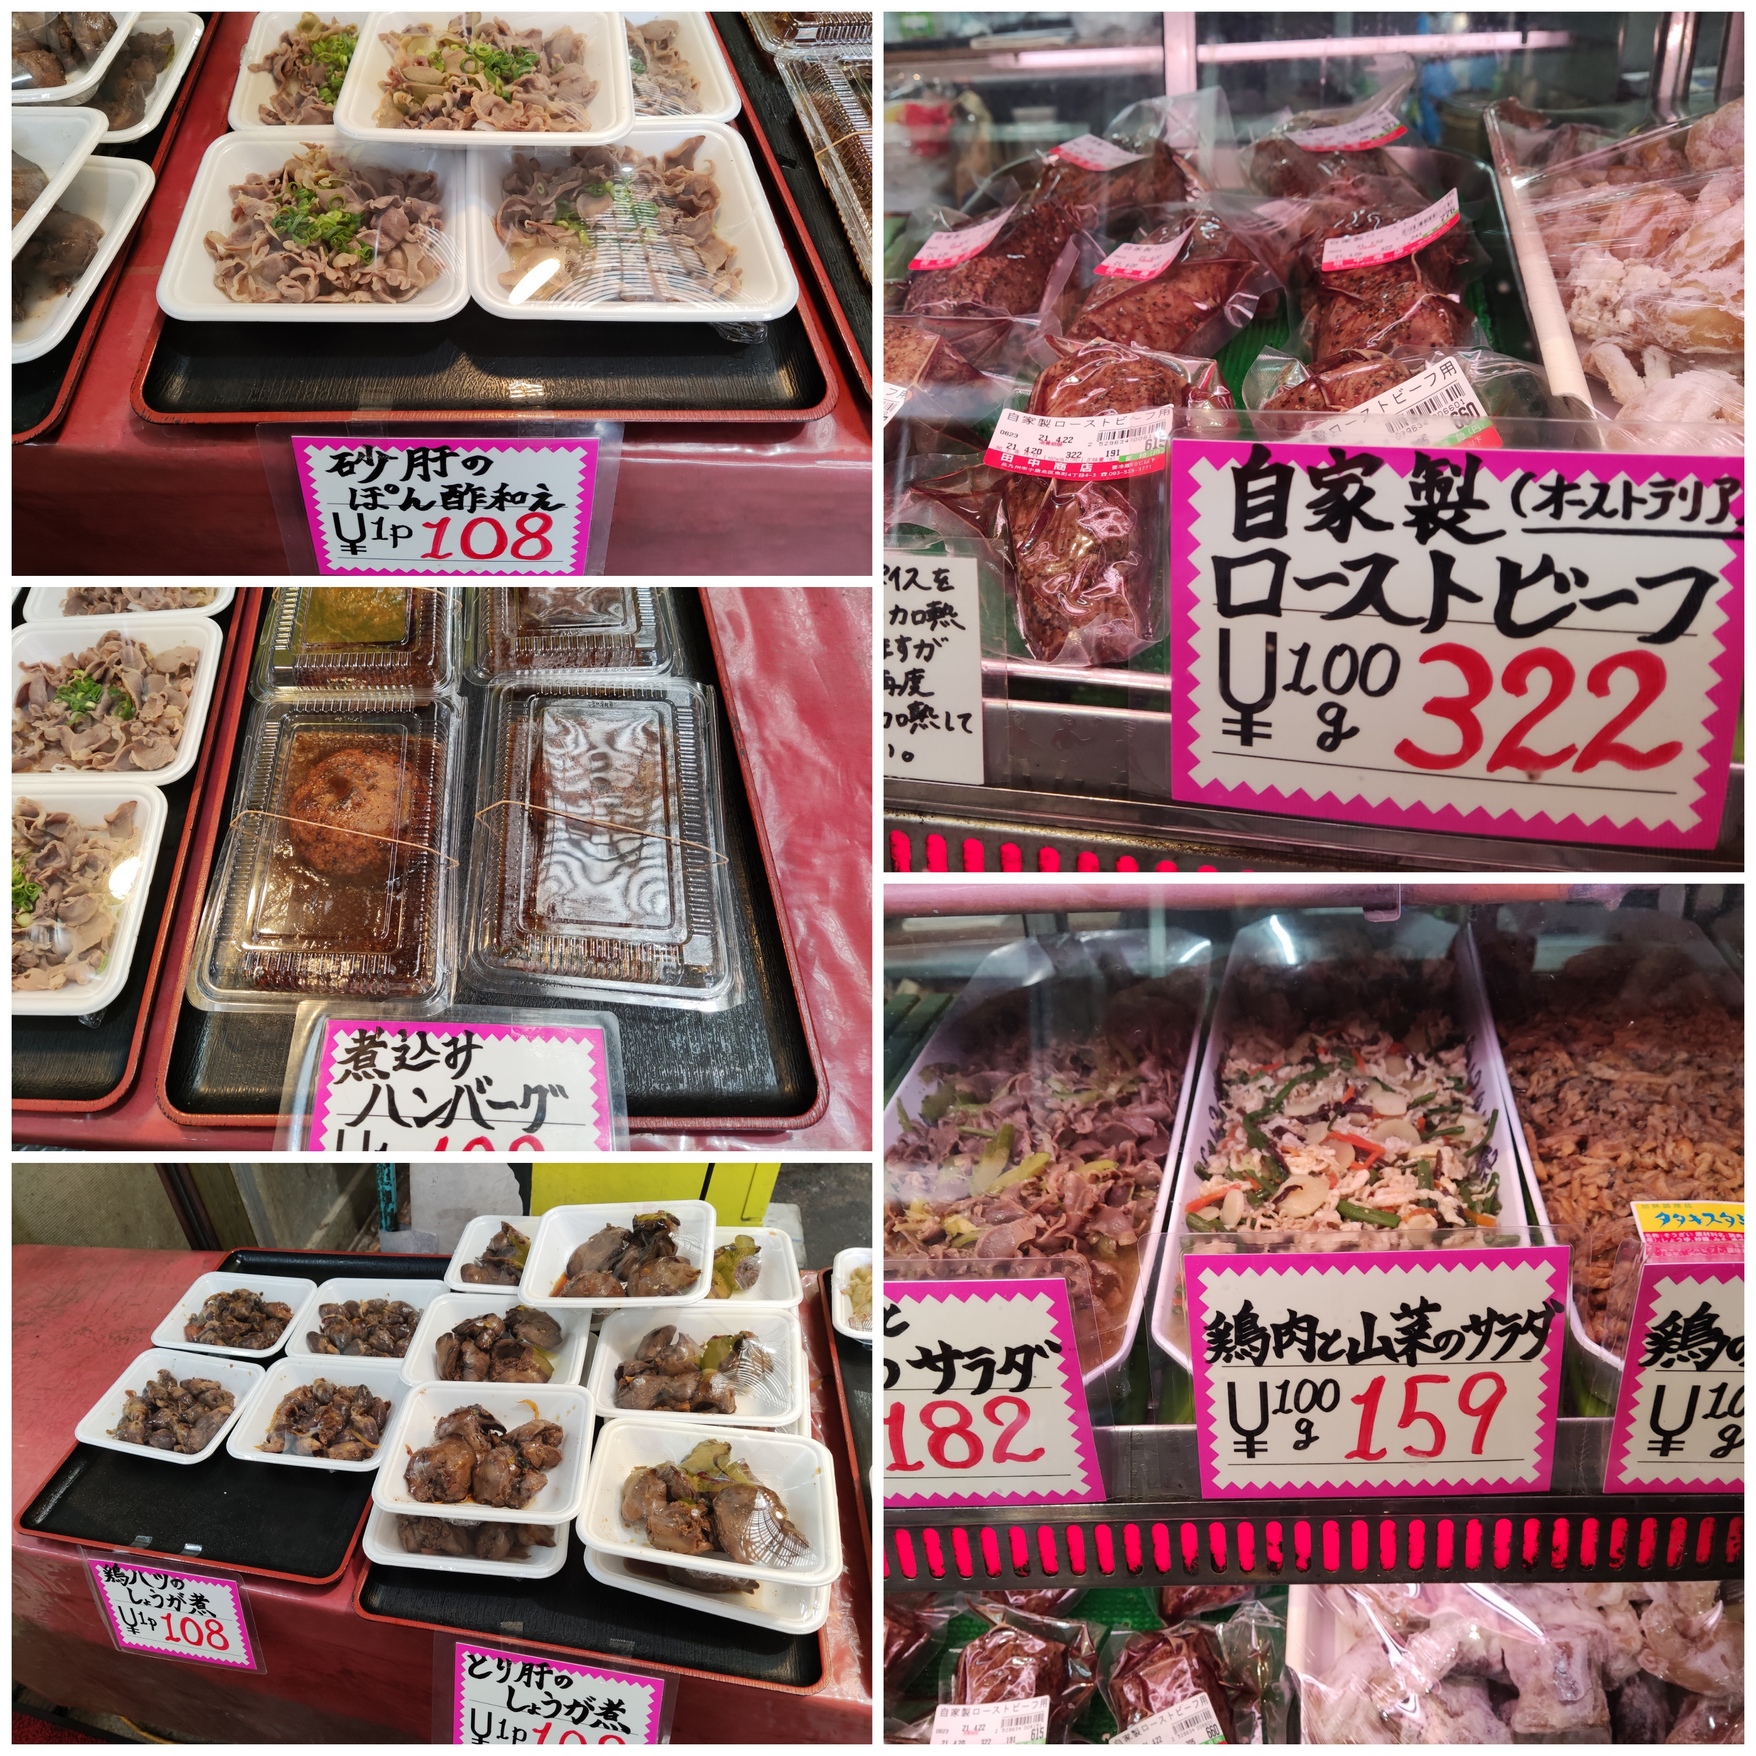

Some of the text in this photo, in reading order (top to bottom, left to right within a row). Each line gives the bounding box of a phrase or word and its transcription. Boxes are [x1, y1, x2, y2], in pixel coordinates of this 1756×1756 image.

[1007, 408, 1171, 428] 自家製ローストビーフ用
[325, 444, 494, 484] 砂肝の
[1000, 452, 1094, 473] 田中商店
[1065, 451, 1083, 459] 322
[1105, 449, 1120, 457] 191
[349, 482, 566, 514] ぽん酢和え
[1231, 442, 1745, 546] 自家製 (オーストラリア
[420, 511, 554, 560] 108
[1210, 546, 1719, 644] ローストビーフ
[1281, 640, 1401, 698] 100
[1392, 641, 1684, 774] 322
[333, 1026, 484, 1085] 煮込み
[344, 1075, 570, 1134] ハンバーグ
[1203, 1295, 1565, 1368] 鶏肉と山菜のサラダ
[884, 1394, 1046, 1472] 182
[1271, 1377, 1341, 1415] 100
[1343, 1370, 1508, 1462] 159
[102, 1563, 185, 1591] 鶏ハツの
[126, 1587, 217, 1618] しょうが煮
[160, 1612, 230, 1651] 108
[466, 1653, 574, 1690] とり肝の
[505, 1685, 631, 1735] しょうが煮
[940, 1697, 1049, 1718] 自家製ローストビーフ用
[1030, 1727, 1045, 1741] 615
[1205, 1723, 1220, 1740] 660
